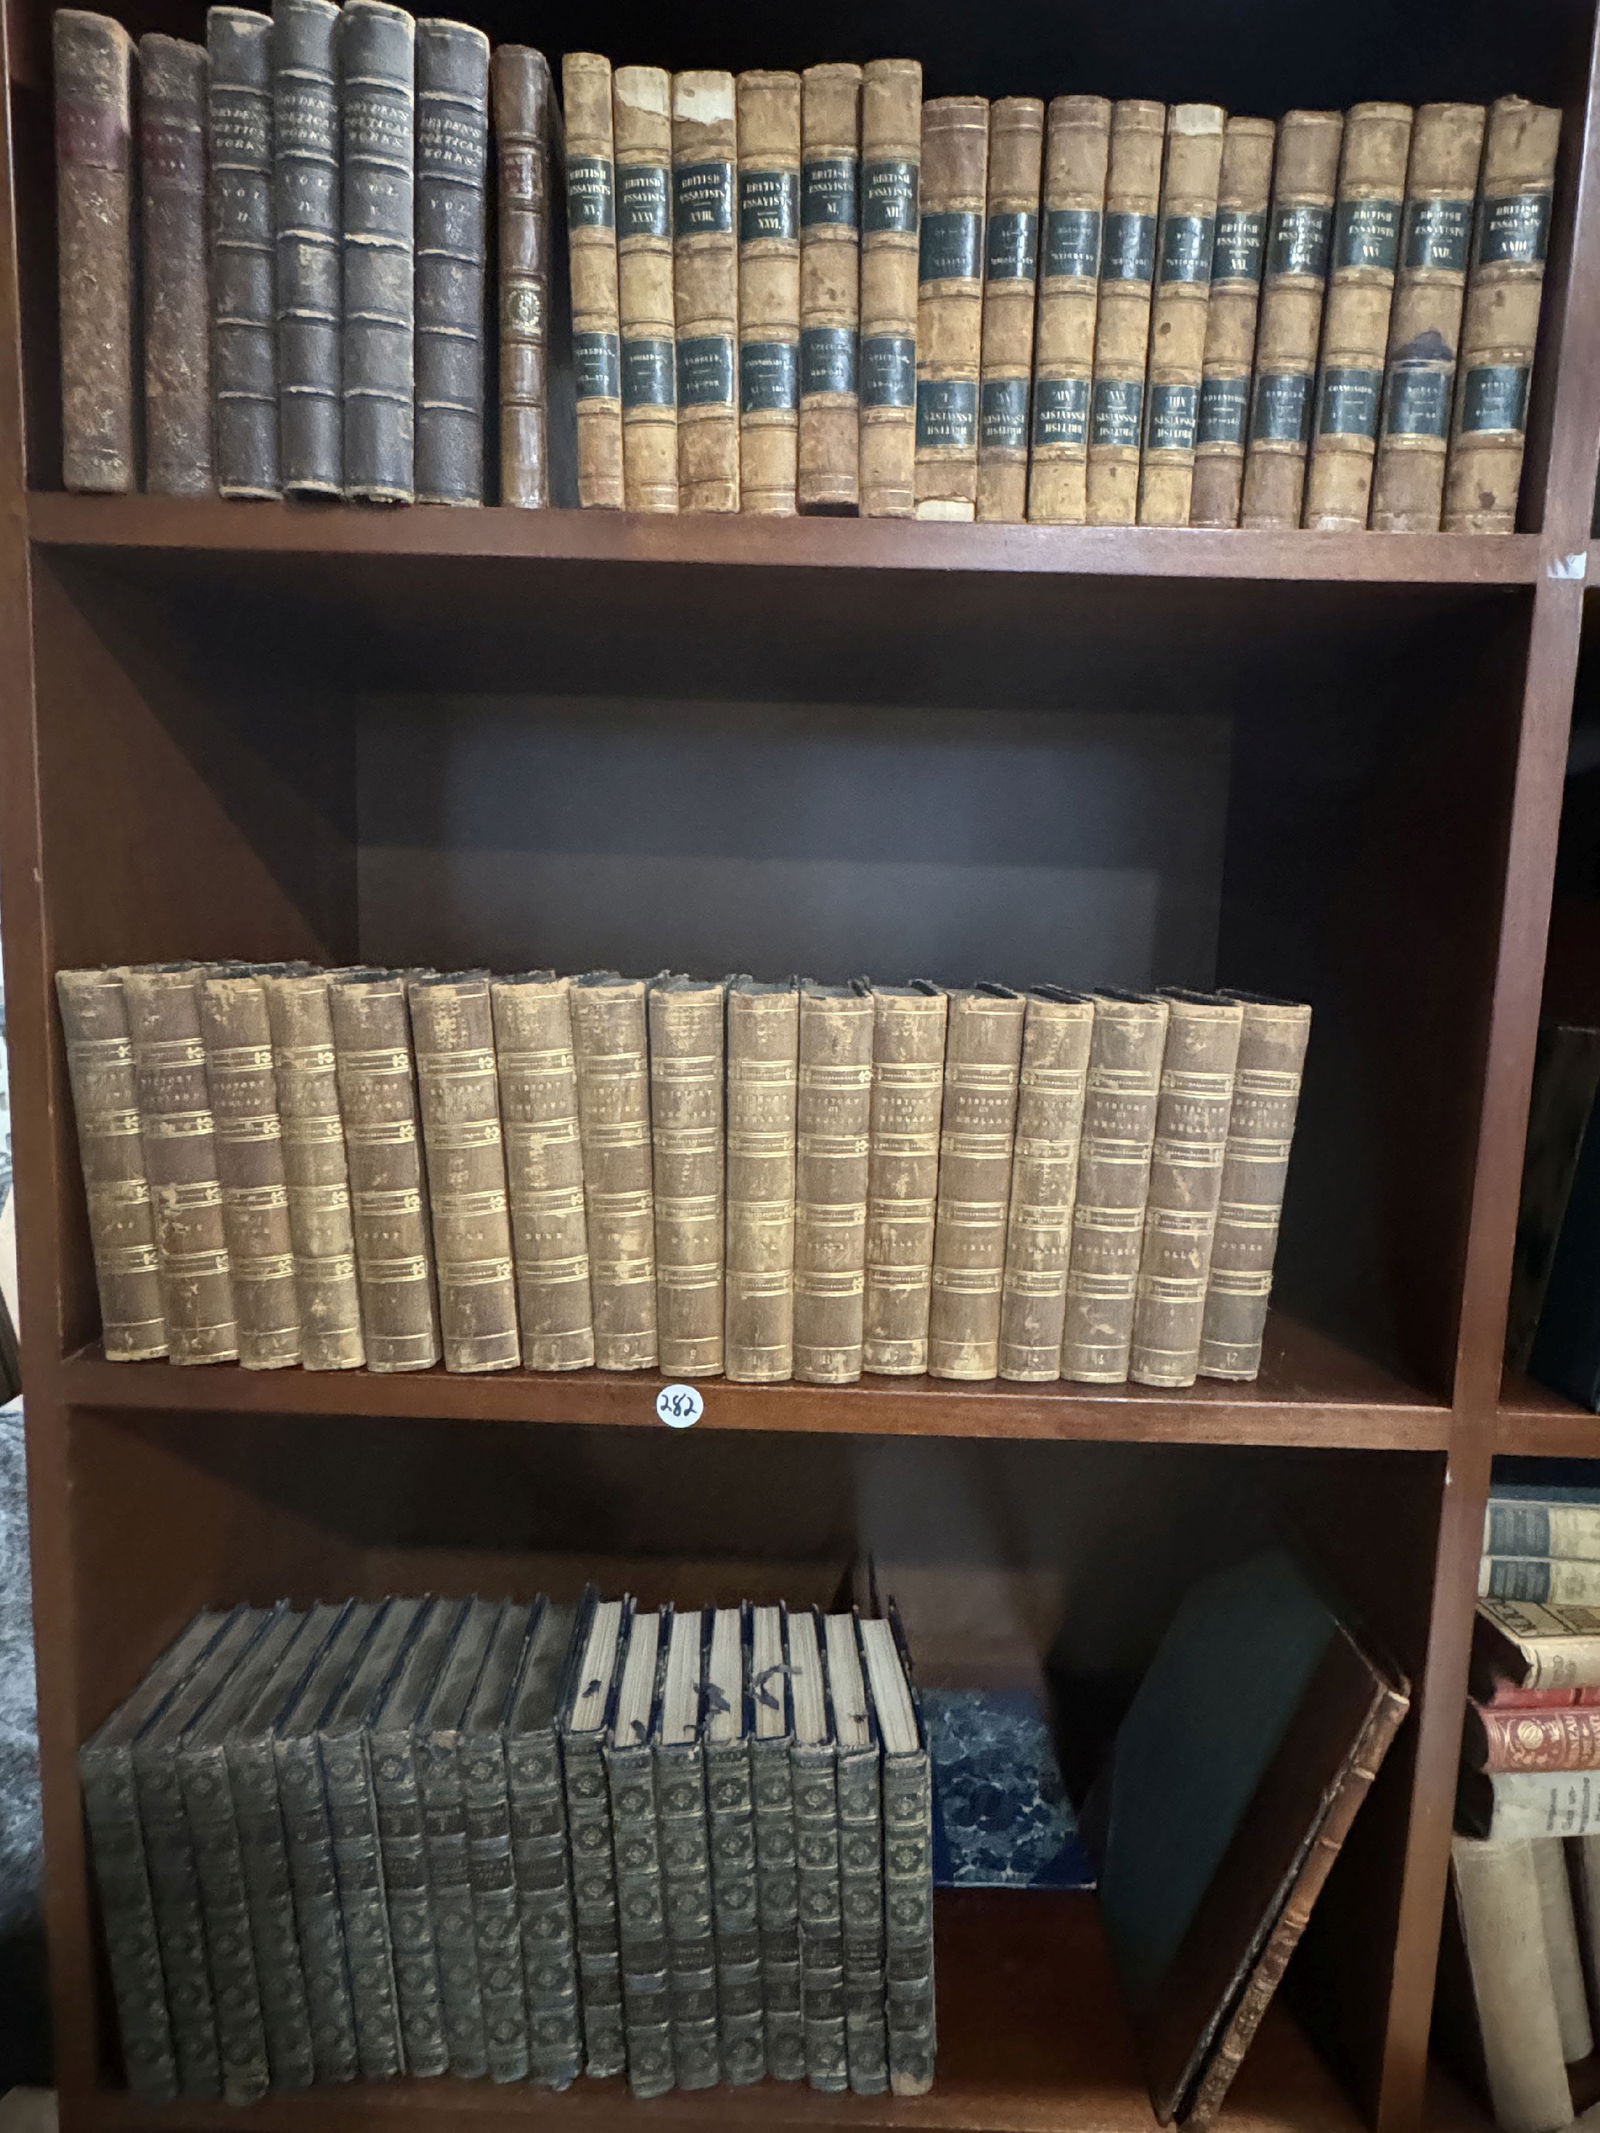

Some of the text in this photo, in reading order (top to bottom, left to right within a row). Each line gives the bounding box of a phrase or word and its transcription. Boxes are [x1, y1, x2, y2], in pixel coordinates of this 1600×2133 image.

[570, 168, 607, 180] BRITISH
[811, 168, 849, 180] BRITISH
[872, 173, 911, 185] BRITISH
[625, 176, 662, 190] BRITISH
[681, 174, 721, 188] BRITISH
[746, 181, 790, 193] BRITISH
[660, 1393, 697, 1417] 282
